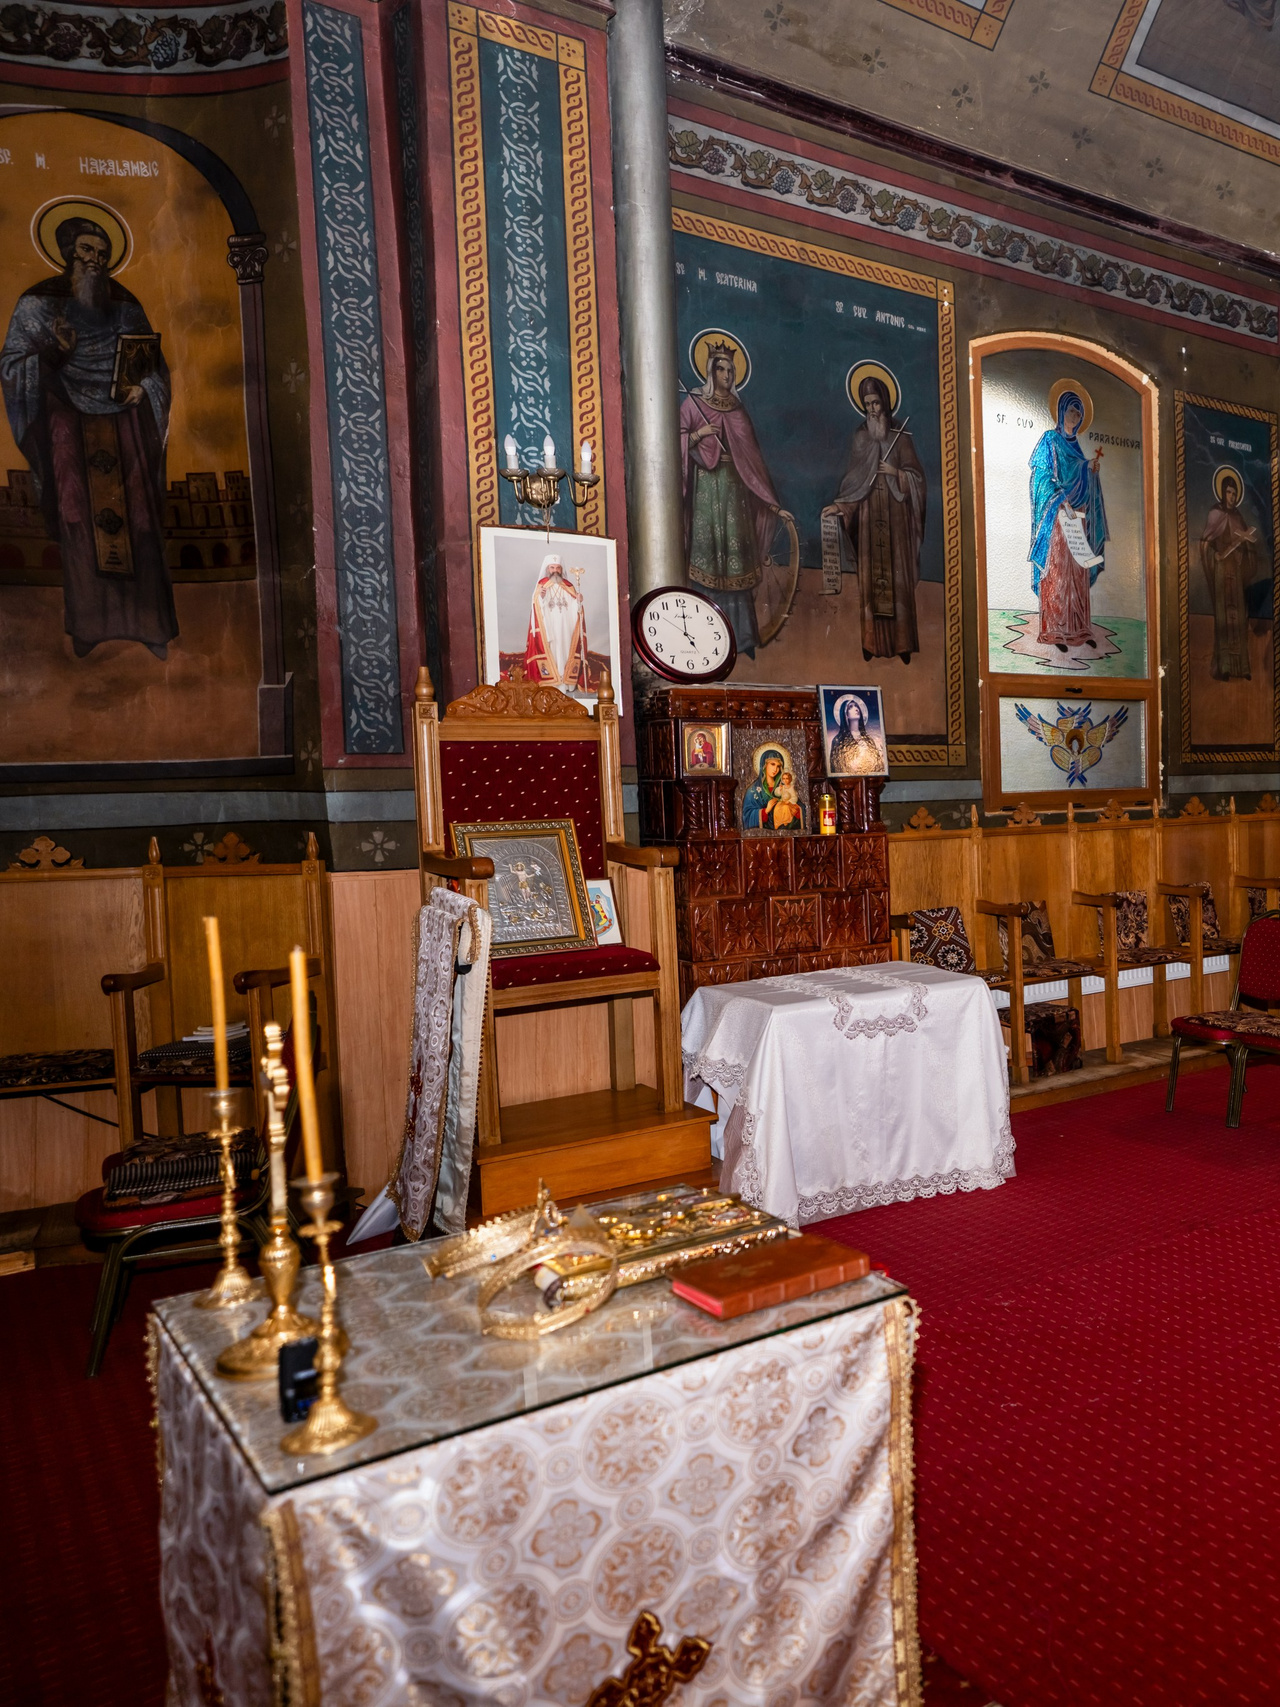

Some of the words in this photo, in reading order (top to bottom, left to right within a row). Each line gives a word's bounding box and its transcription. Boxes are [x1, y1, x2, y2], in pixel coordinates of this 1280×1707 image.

[1088, 431, 1141, 450] PARASCHEVA
[661, 601, 669, 611] 11
[675, 598, 687, 608] 12
[695, 604, 700, 613] 1
[649, 611, 660, 621] 10
[706, 616, 714, 626] 2
[648, 626, 657, 637] 9
[713, 631, 722, 641] 3
[655, 642, 664, 653] 8
[711, 647, 720, 656] 4
[669, 655, 676, 664] 7
[686, 659, 695, 670] 6
[702, 656, 710, 666] 5
